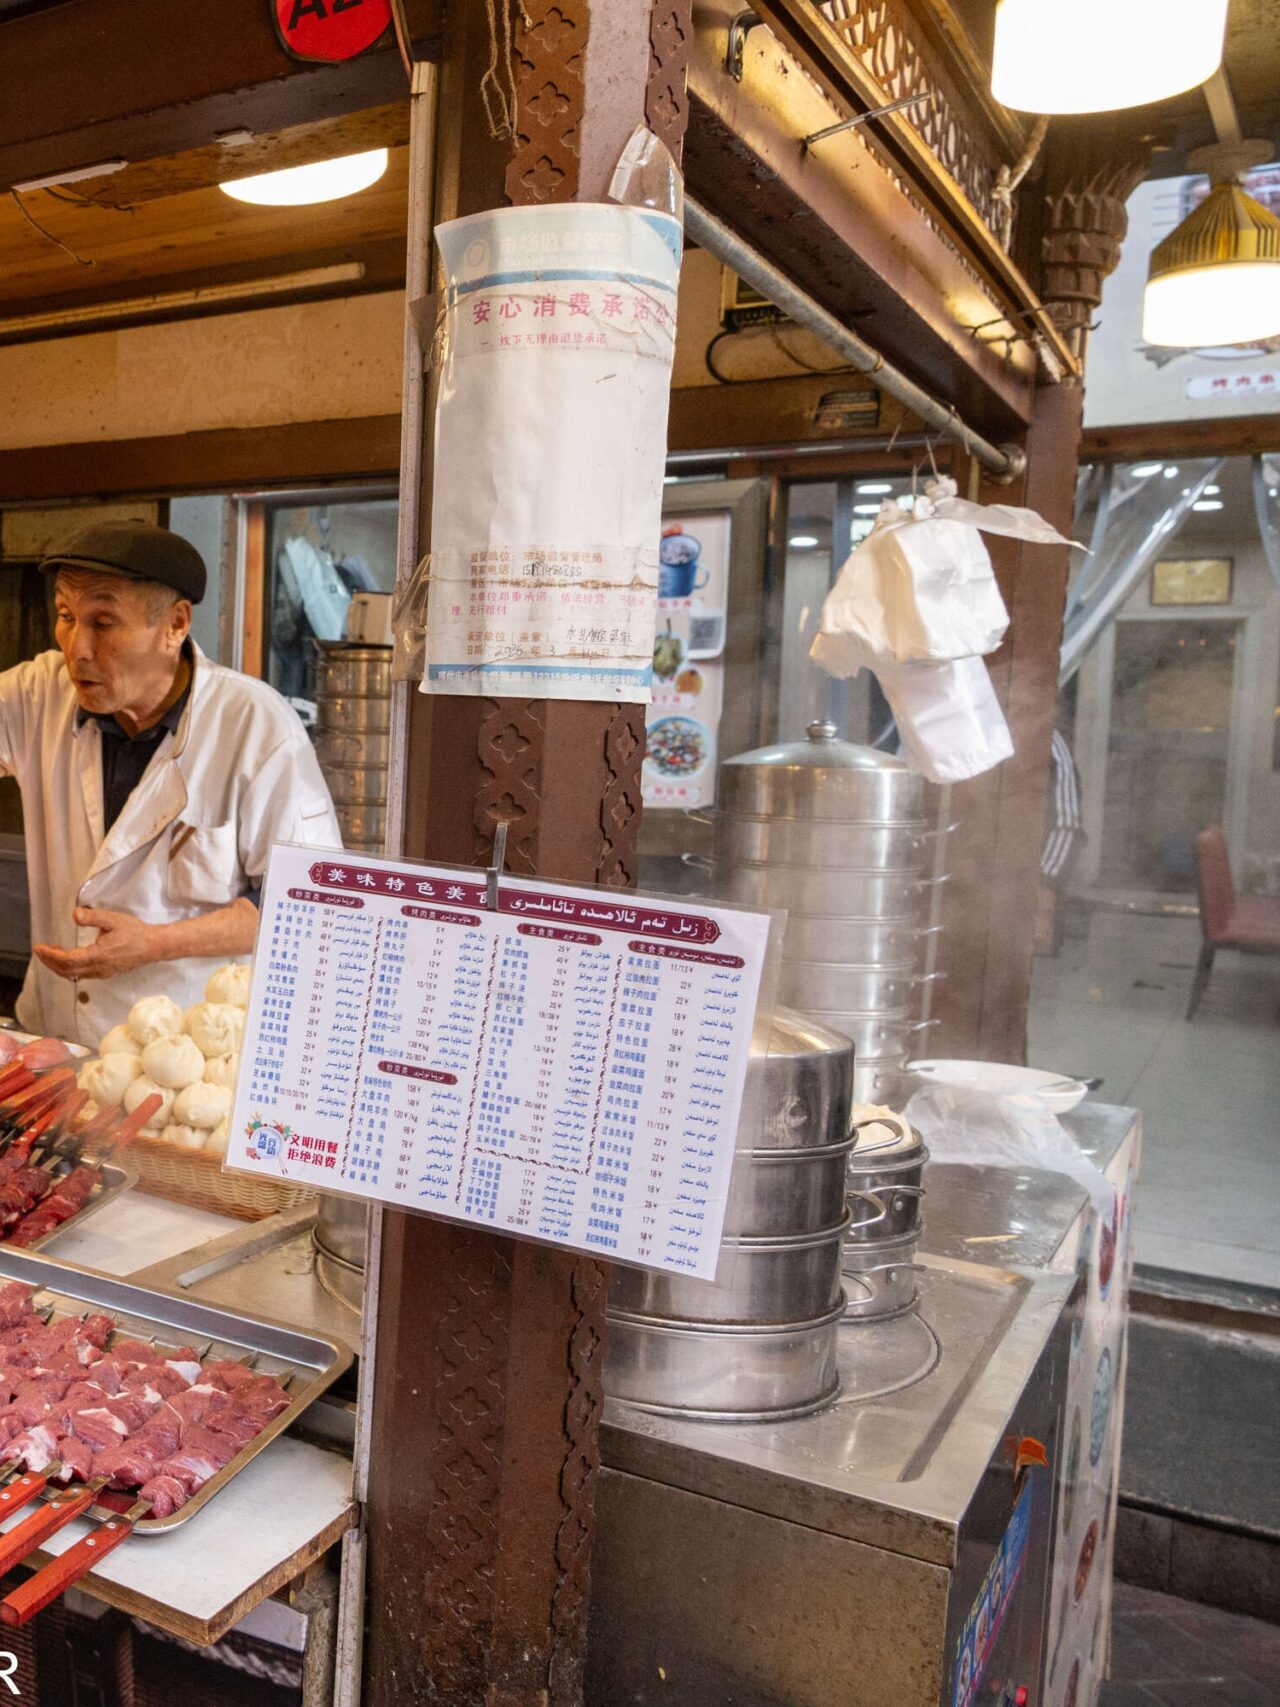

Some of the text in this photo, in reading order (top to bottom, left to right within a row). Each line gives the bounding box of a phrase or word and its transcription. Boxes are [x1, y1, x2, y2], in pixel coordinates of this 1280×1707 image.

[289, 1133, 338, 1154] 文明用餐
[287, 1147, 336, 1169] 拒绝浪费
